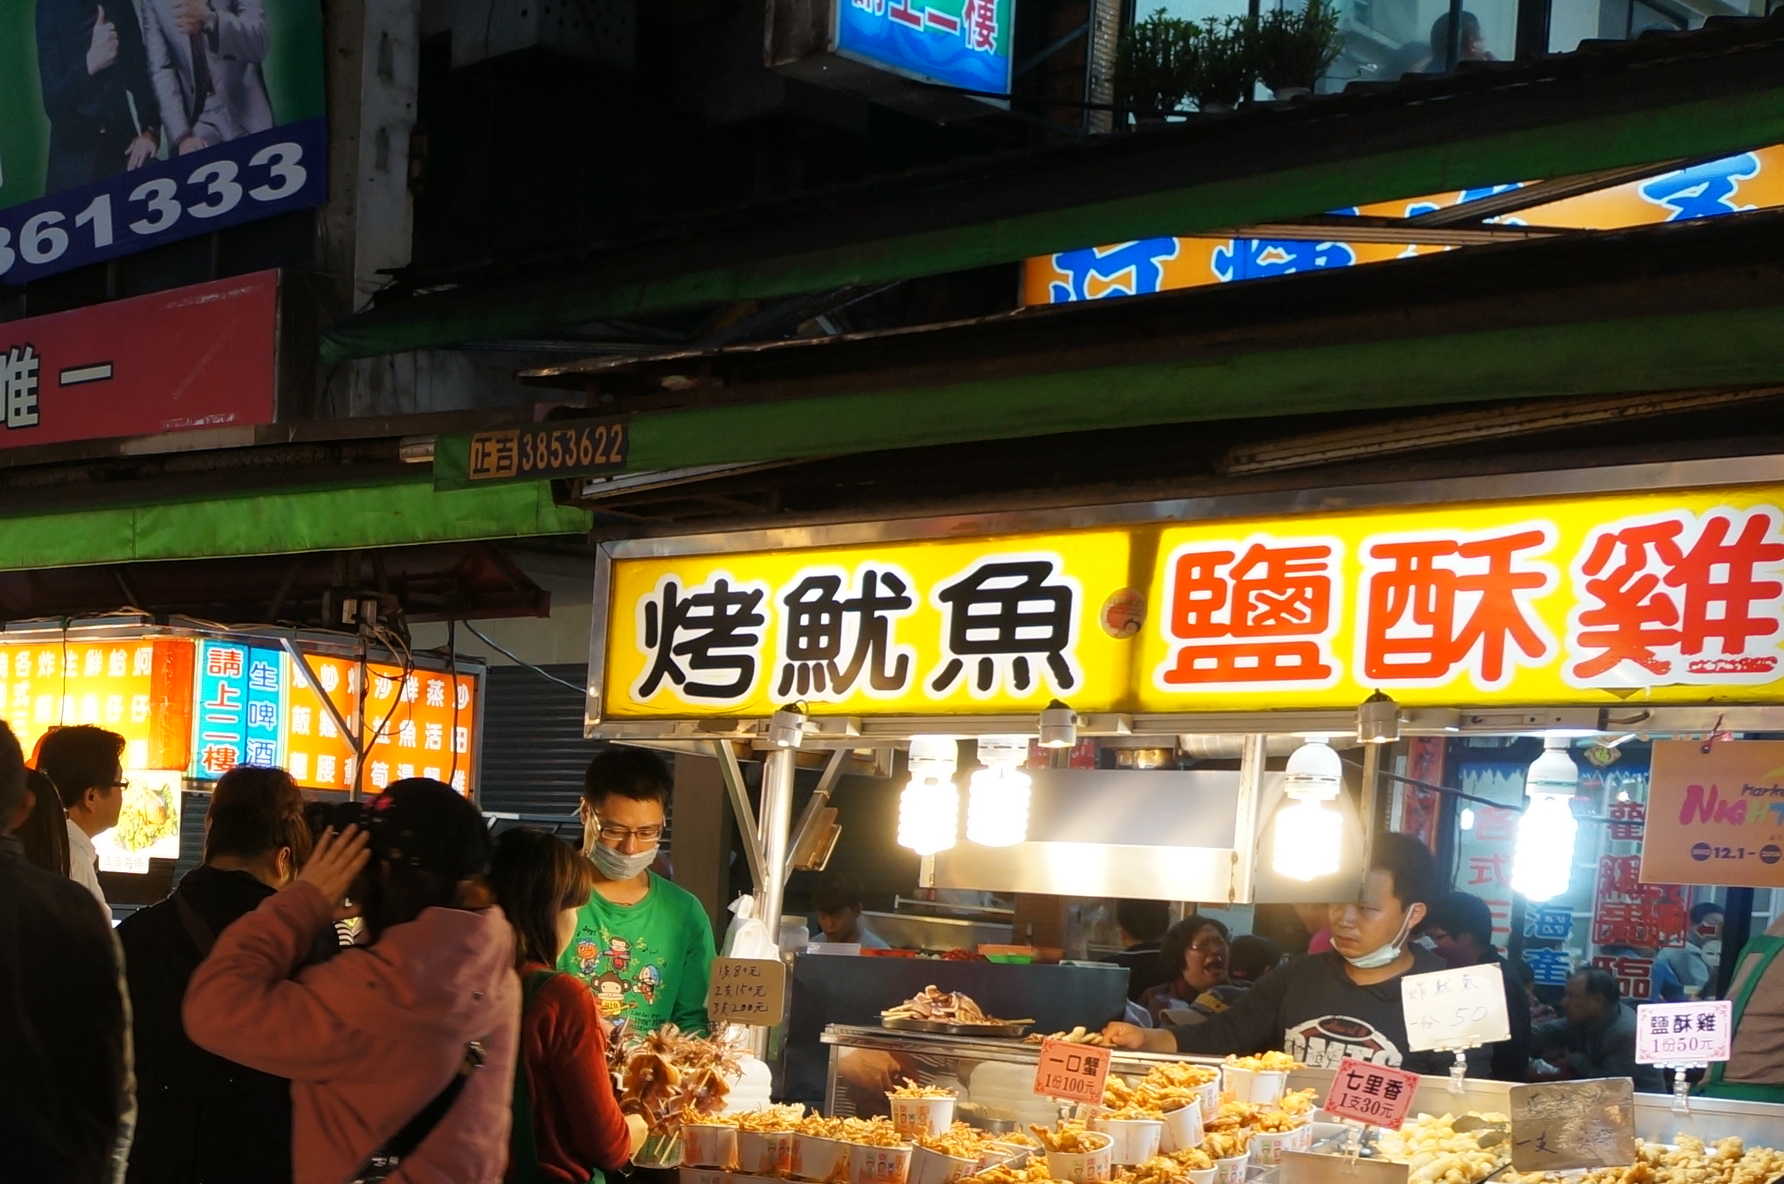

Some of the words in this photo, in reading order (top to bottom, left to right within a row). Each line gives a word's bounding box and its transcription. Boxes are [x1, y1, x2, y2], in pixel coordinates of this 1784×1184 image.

[472, 436, 515, 474] 正吉
[522, 423, 623, 471] 3853622
[1162, 507, 1783, 685] 鹽酥雞
[638, 561, 1076, 700] 烤魷魚
[202, 646, 244, 773] 請上二樓
[246, 661, 279, 767] 生啤酒
[1450, 1005, 1488, 1028] 50
[1650, 1012, 1717, 1035] 鹽酥雞
[1650, 1036, 1715, 1054] 1份50元
[1048, 1054, 1101, 1078] 一口蟹
[1044, 1073, 1096, 1096] 1份100元
[1345, 1068, 1404, 1101] 七里香
[1338, 1090, 1395, 1120] 1支30元
